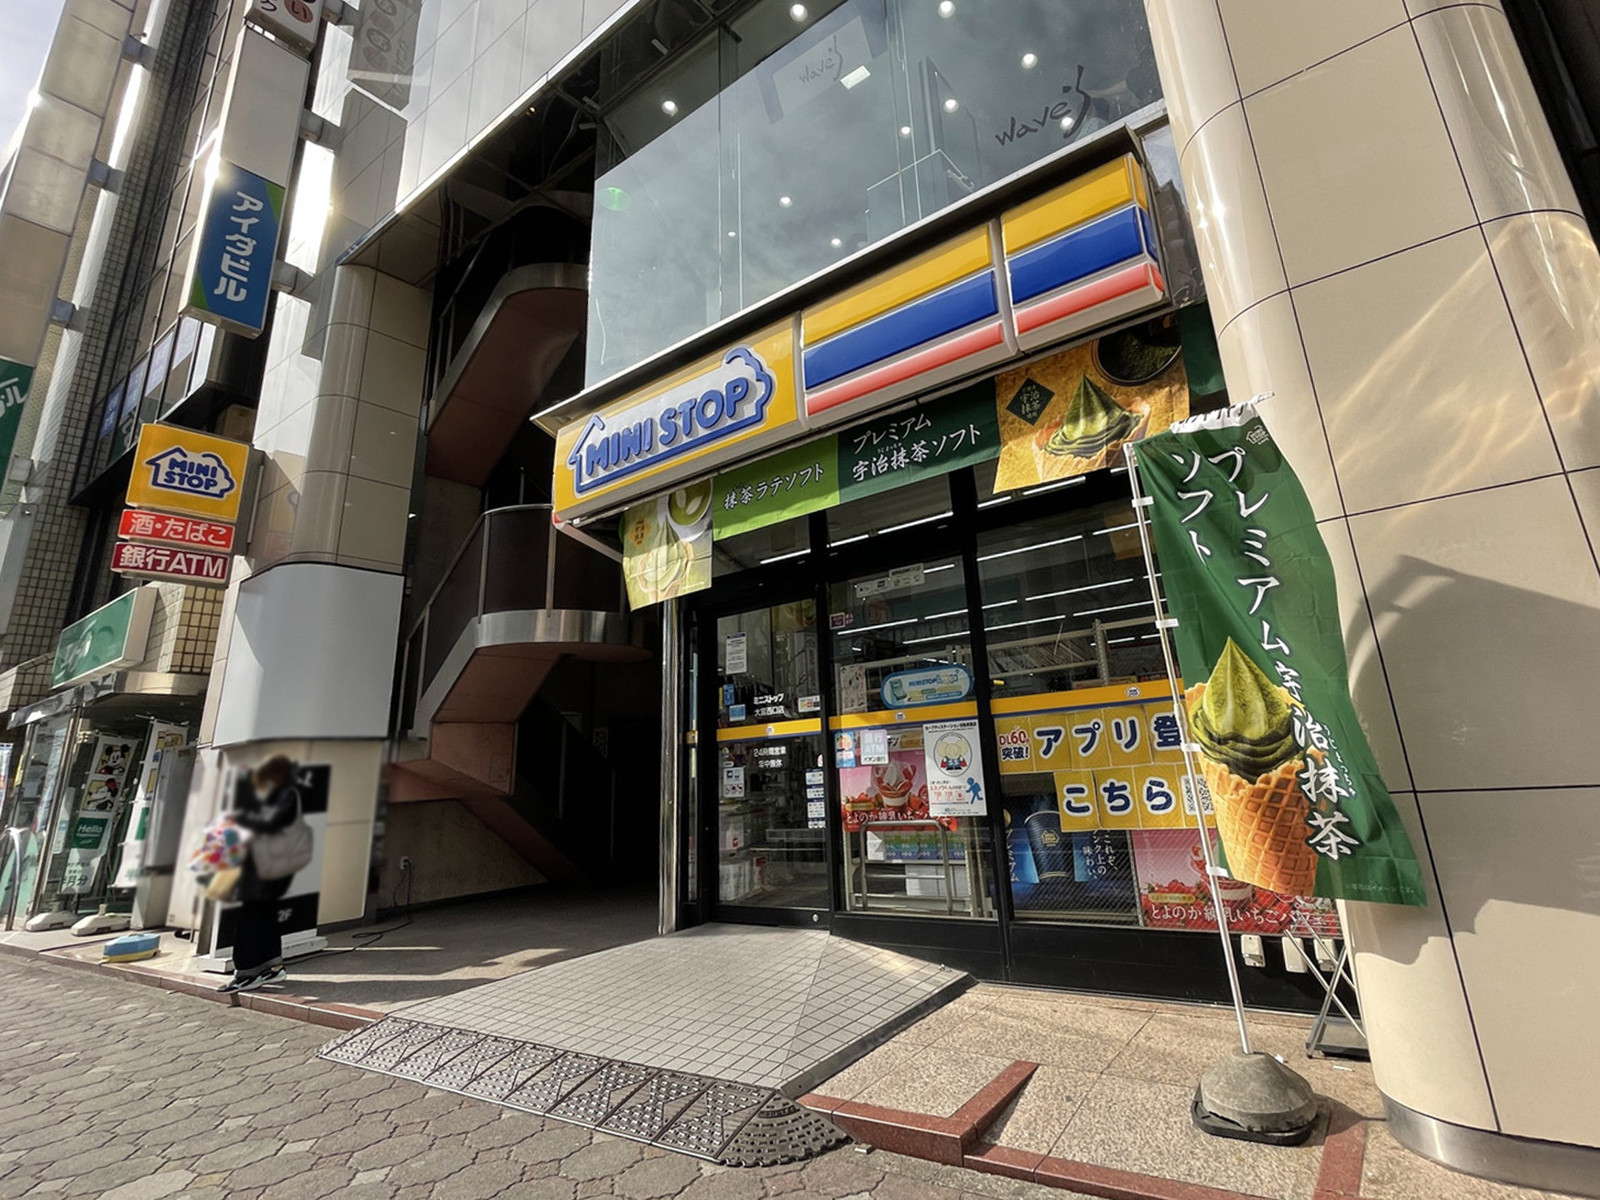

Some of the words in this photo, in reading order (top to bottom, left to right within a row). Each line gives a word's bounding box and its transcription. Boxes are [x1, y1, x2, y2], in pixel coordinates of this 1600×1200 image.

[213, 191, 263, 302] アイダビル
[585, 417, 653, 477] MINI
[659, 377, 749, 446] STOP
[853, 413, 931, 454] プレミアム
[168, 457, 217, 477] MINI
[852, 424, 980, 481] 宇治抹茶ソフト
[164, 471, 217, 490] STOP
[724, 463, 823, 509] 抹茶ラテソフト
[1172, 450, 1213, 566] ソフト
[129, 513, 227, 545] 酒・たばこ
[119, 545, 224, 578] 銀行ATM
[1065, 780, 1173, 812] こちら
